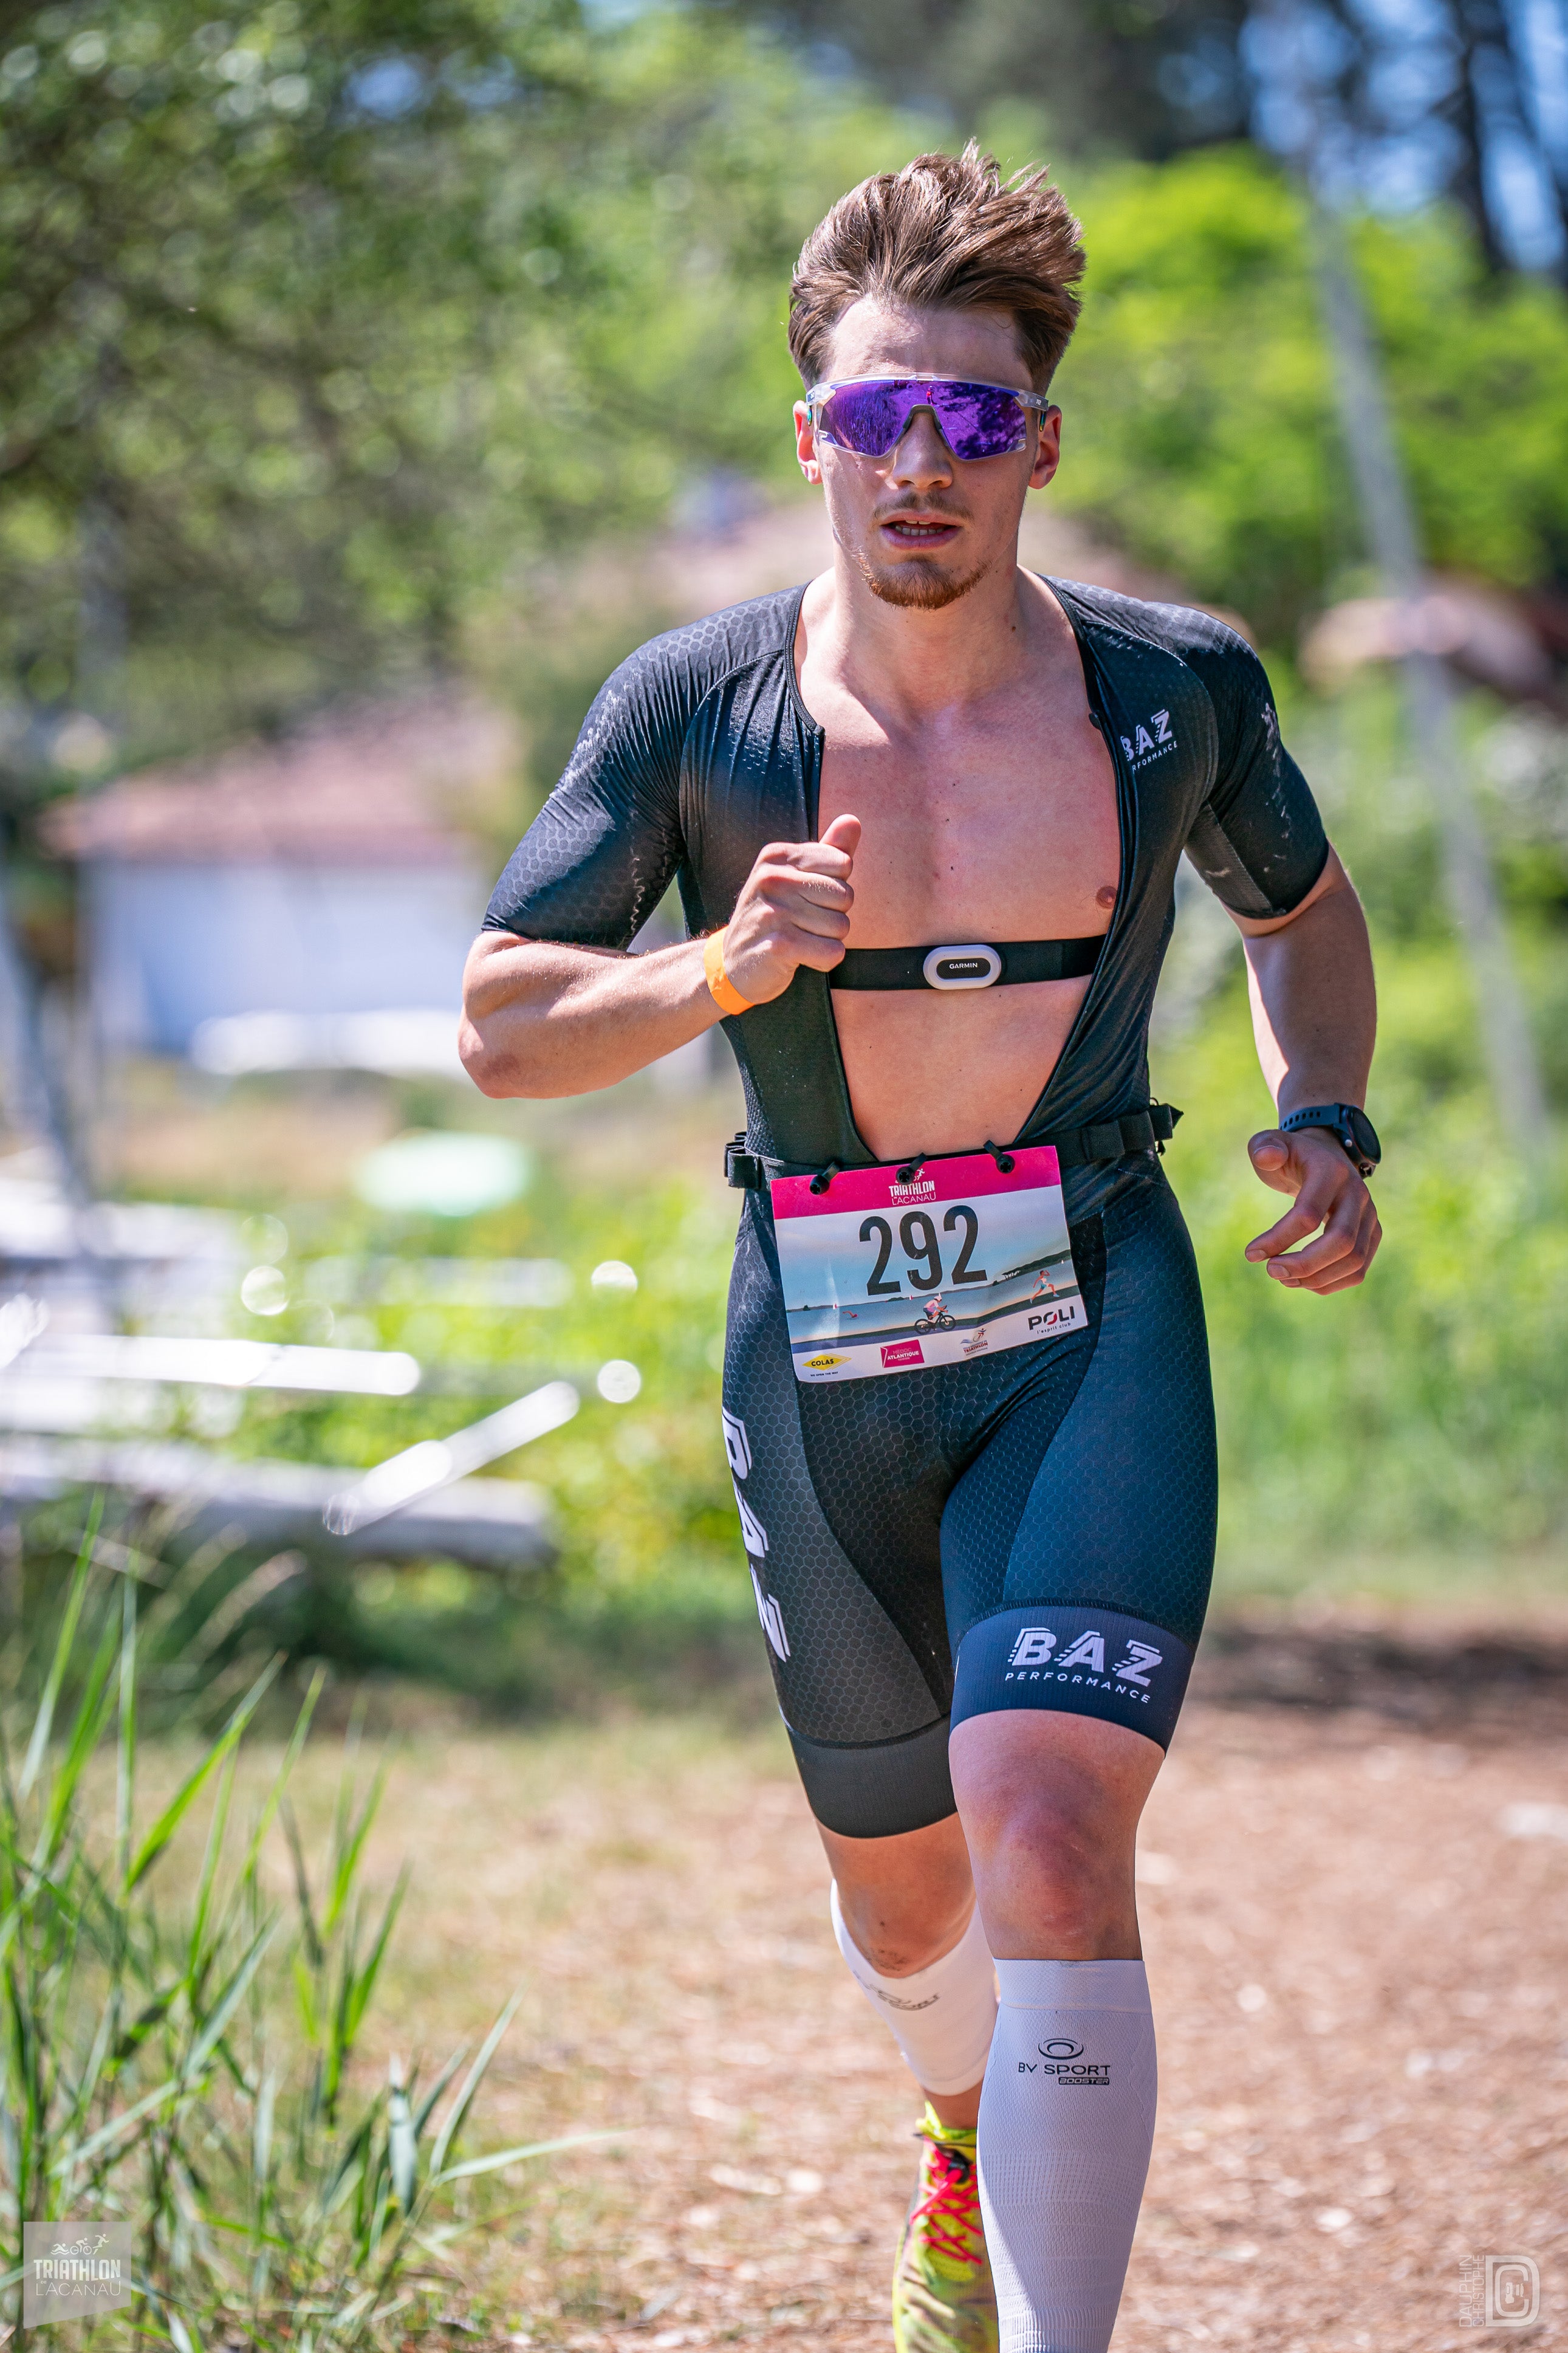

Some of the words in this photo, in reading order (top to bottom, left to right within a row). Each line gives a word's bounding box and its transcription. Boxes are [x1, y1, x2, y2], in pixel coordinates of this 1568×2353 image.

[1120, 709, 1173, 761] BAZ
[1132, 741, 1177, 774] RFORMANCE
[888, 1180, 935, 1197] TRIATHLON
[892, 1192, 936, 1205] LACANAU
[859, 1204, 988, 1296] 292
[1028, 1305, 1075, 1331] POLI
[887, 1350, 919, 1360] ATLANTIQUE
[964, 1342, 988, 1353] TRIATHLON
[811, 1358, 834, 1367] COLAS
[1007, 1627, 1163, 1687] BAZ
[1005, 1671, 1151, 1703] PERFORMANCE
[1018, 2062, 1038, 2073] BY
[1044, 2064, 1111, 2076] SPORT
